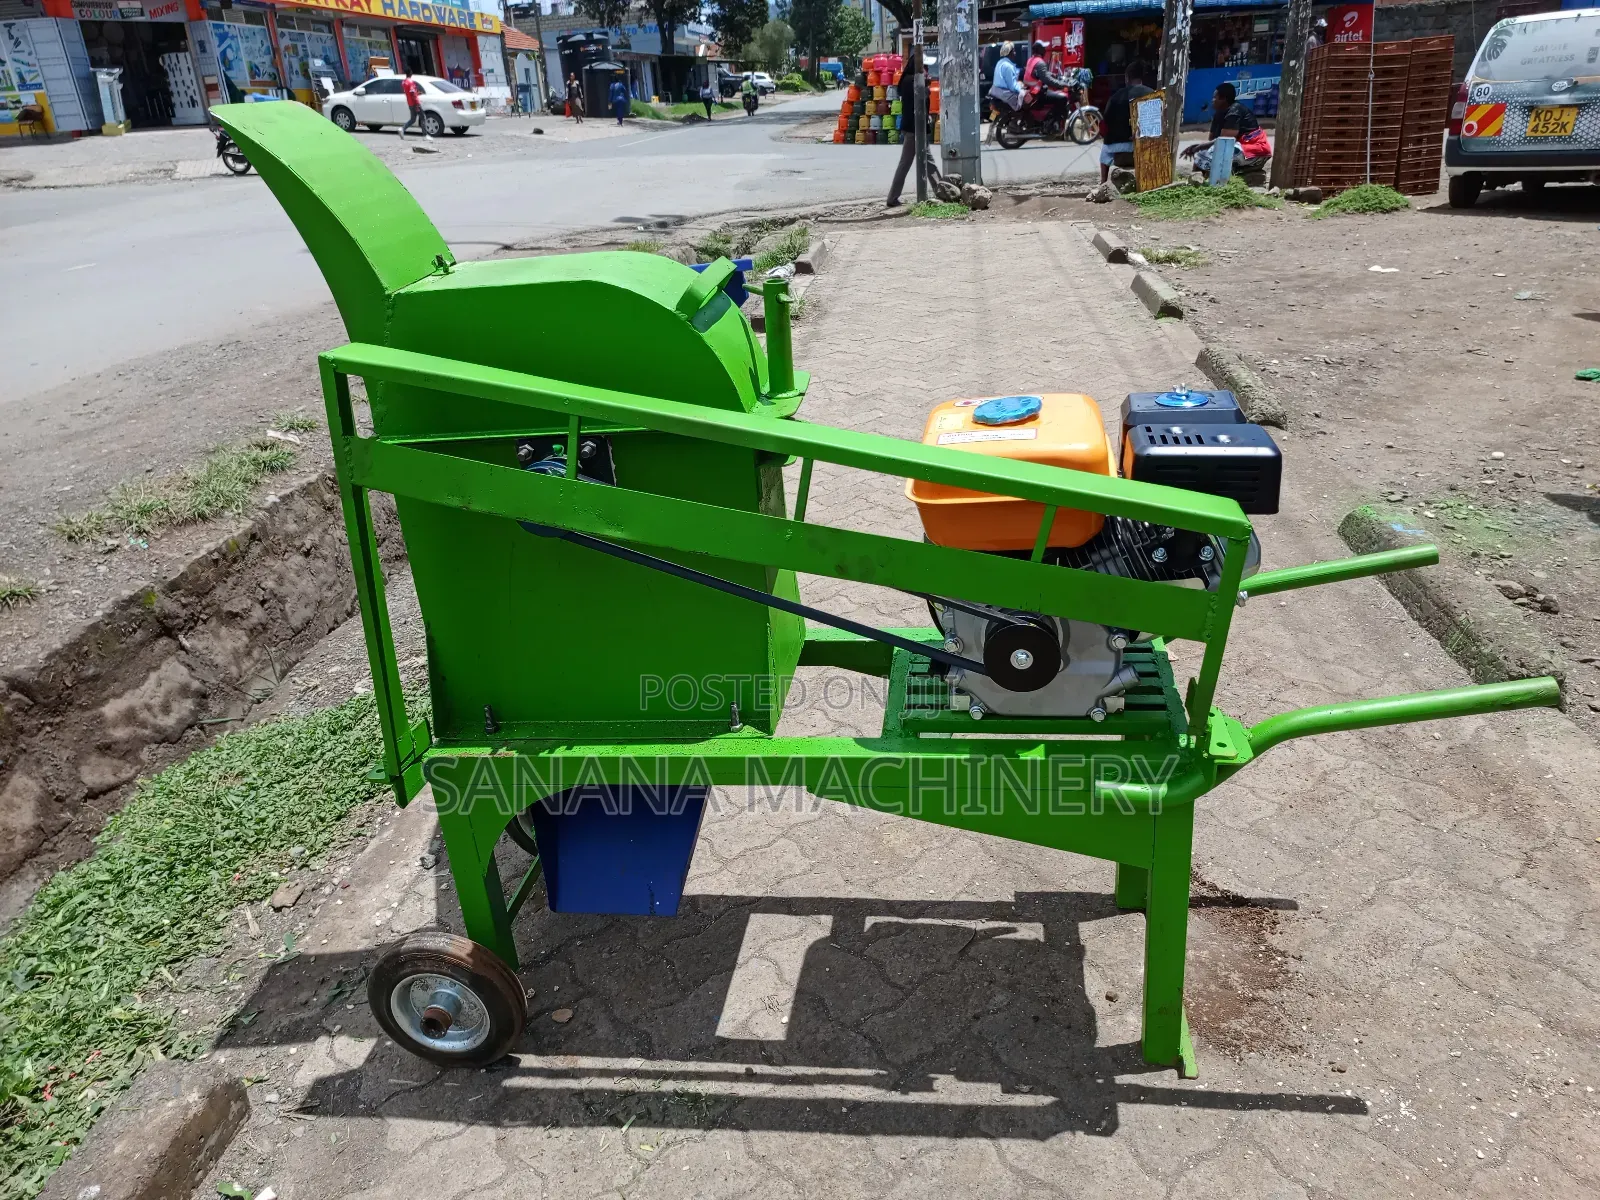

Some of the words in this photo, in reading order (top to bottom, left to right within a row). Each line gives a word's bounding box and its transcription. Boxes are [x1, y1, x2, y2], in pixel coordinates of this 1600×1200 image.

[79, 8, 119, 19] COLOUR
[148, 2, 179, 19] MIXING
[381, 0, 477, 29] HARDWARE
[1334, 30, 1363, 43] airtel
[1476, 86, 1490, 97] 80
[1533, 110, 1563, 122] KDJ
[1530, 121, 1570, 134] 452K
